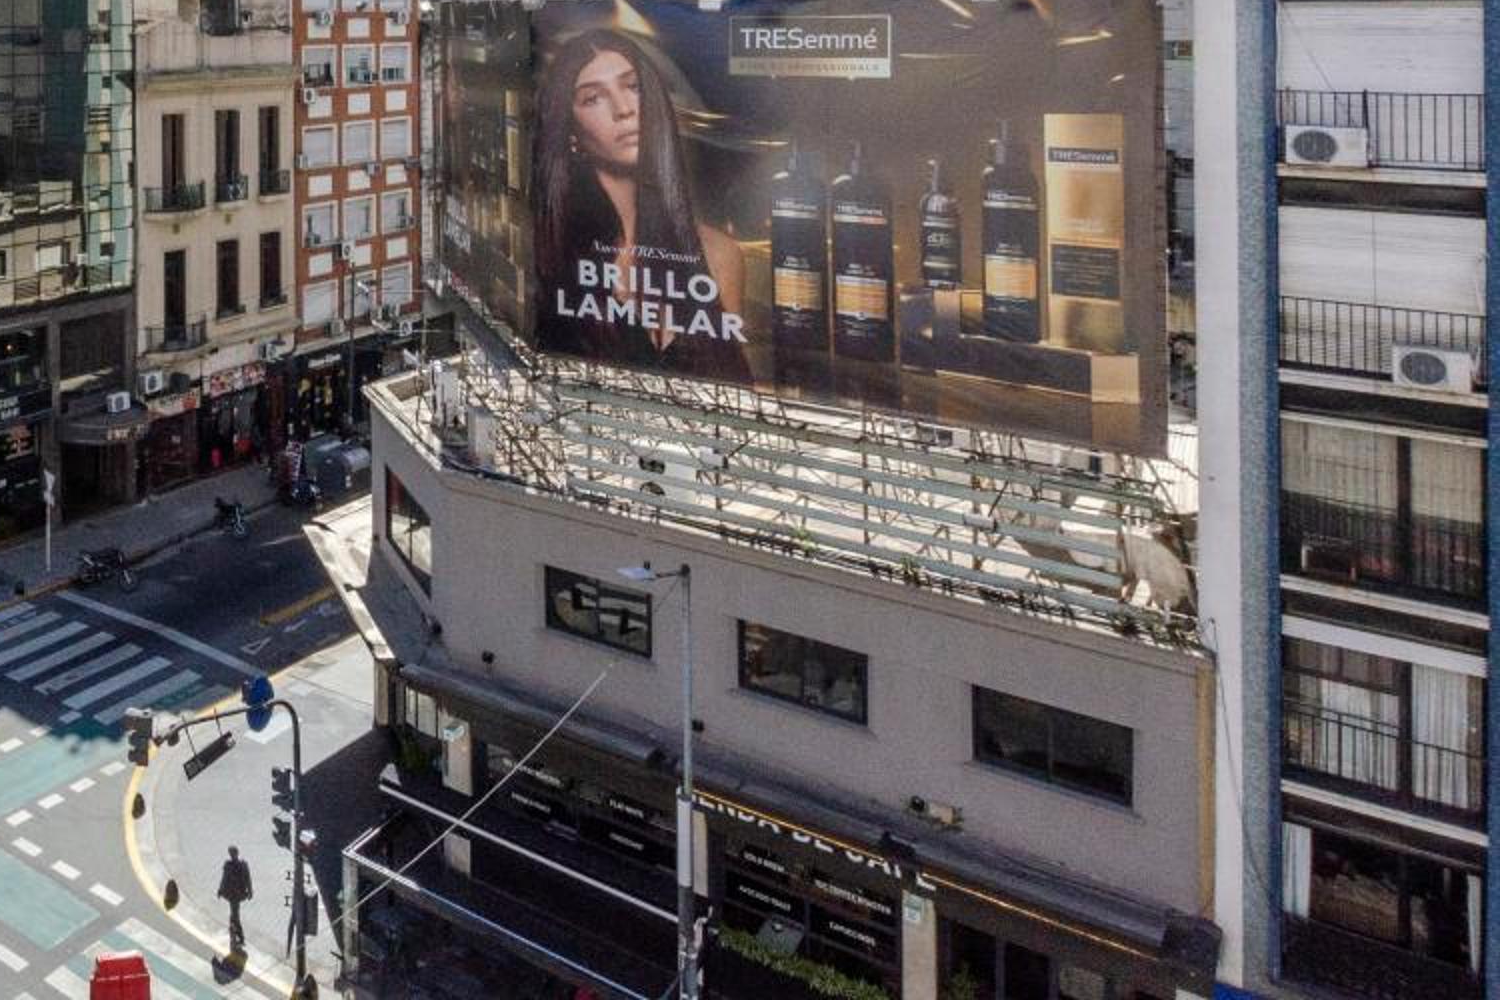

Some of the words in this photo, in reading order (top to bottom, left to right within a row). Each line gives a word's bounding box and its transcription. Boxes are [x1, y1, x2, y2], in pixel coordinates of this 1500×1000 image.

[740, 27, 878, 50] TRESemmé
[578, 259, 718, 302] BRILLO
[557, 288, 749, 343] LAMELAR
